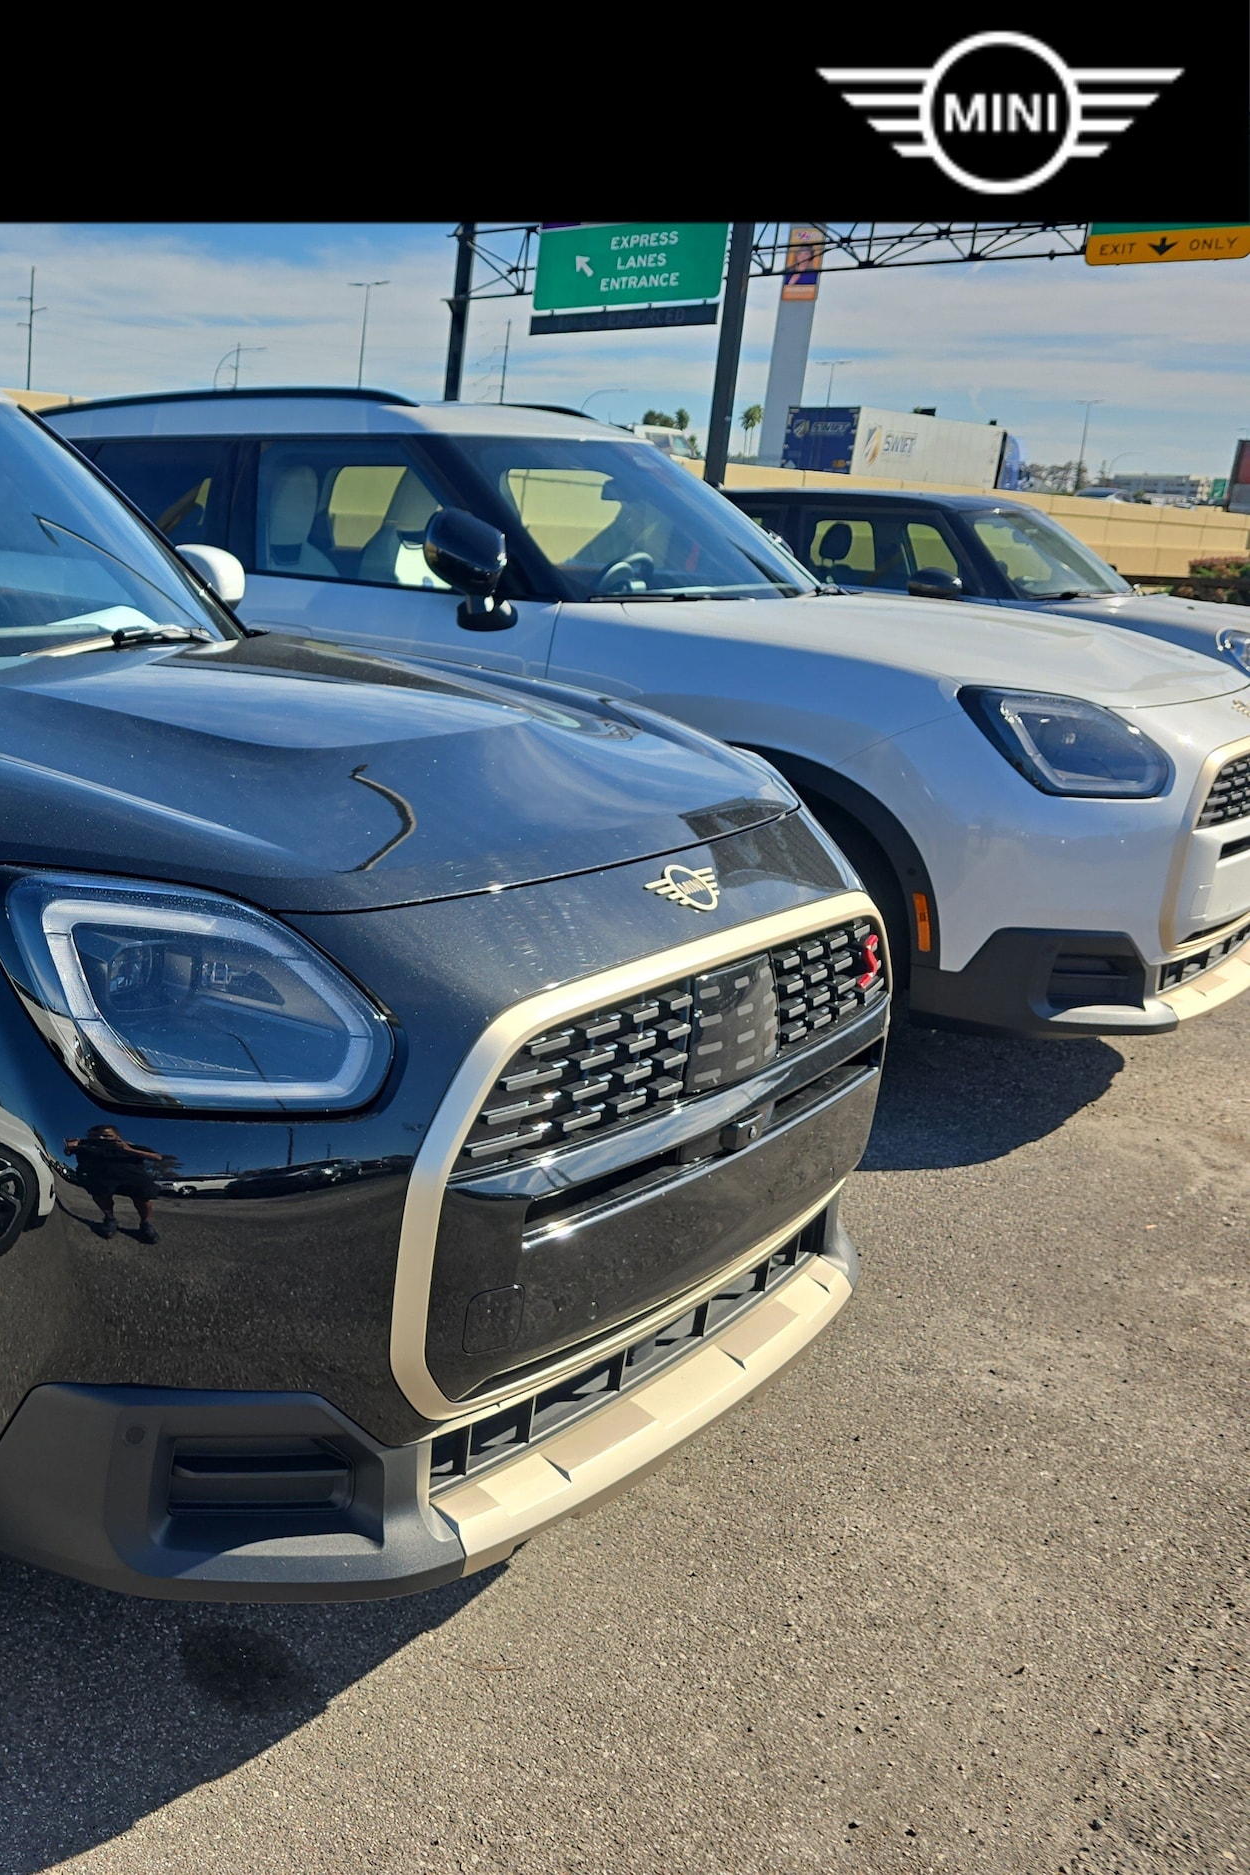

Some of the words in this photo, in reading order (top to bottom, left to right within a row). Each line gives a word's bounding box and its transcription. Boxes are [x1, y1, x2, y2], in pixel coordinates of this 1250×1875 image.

[610, 231, 679, 250] EXPRESS
[1099, 242, 1136, 256] EXIT
[1189, 236, 1238, 251] ONLY
[616, 252, 667, 270] LANES
[600, 272, 680, 291] ENTRANCE
[882, 432, 916, 454] SWIFT
